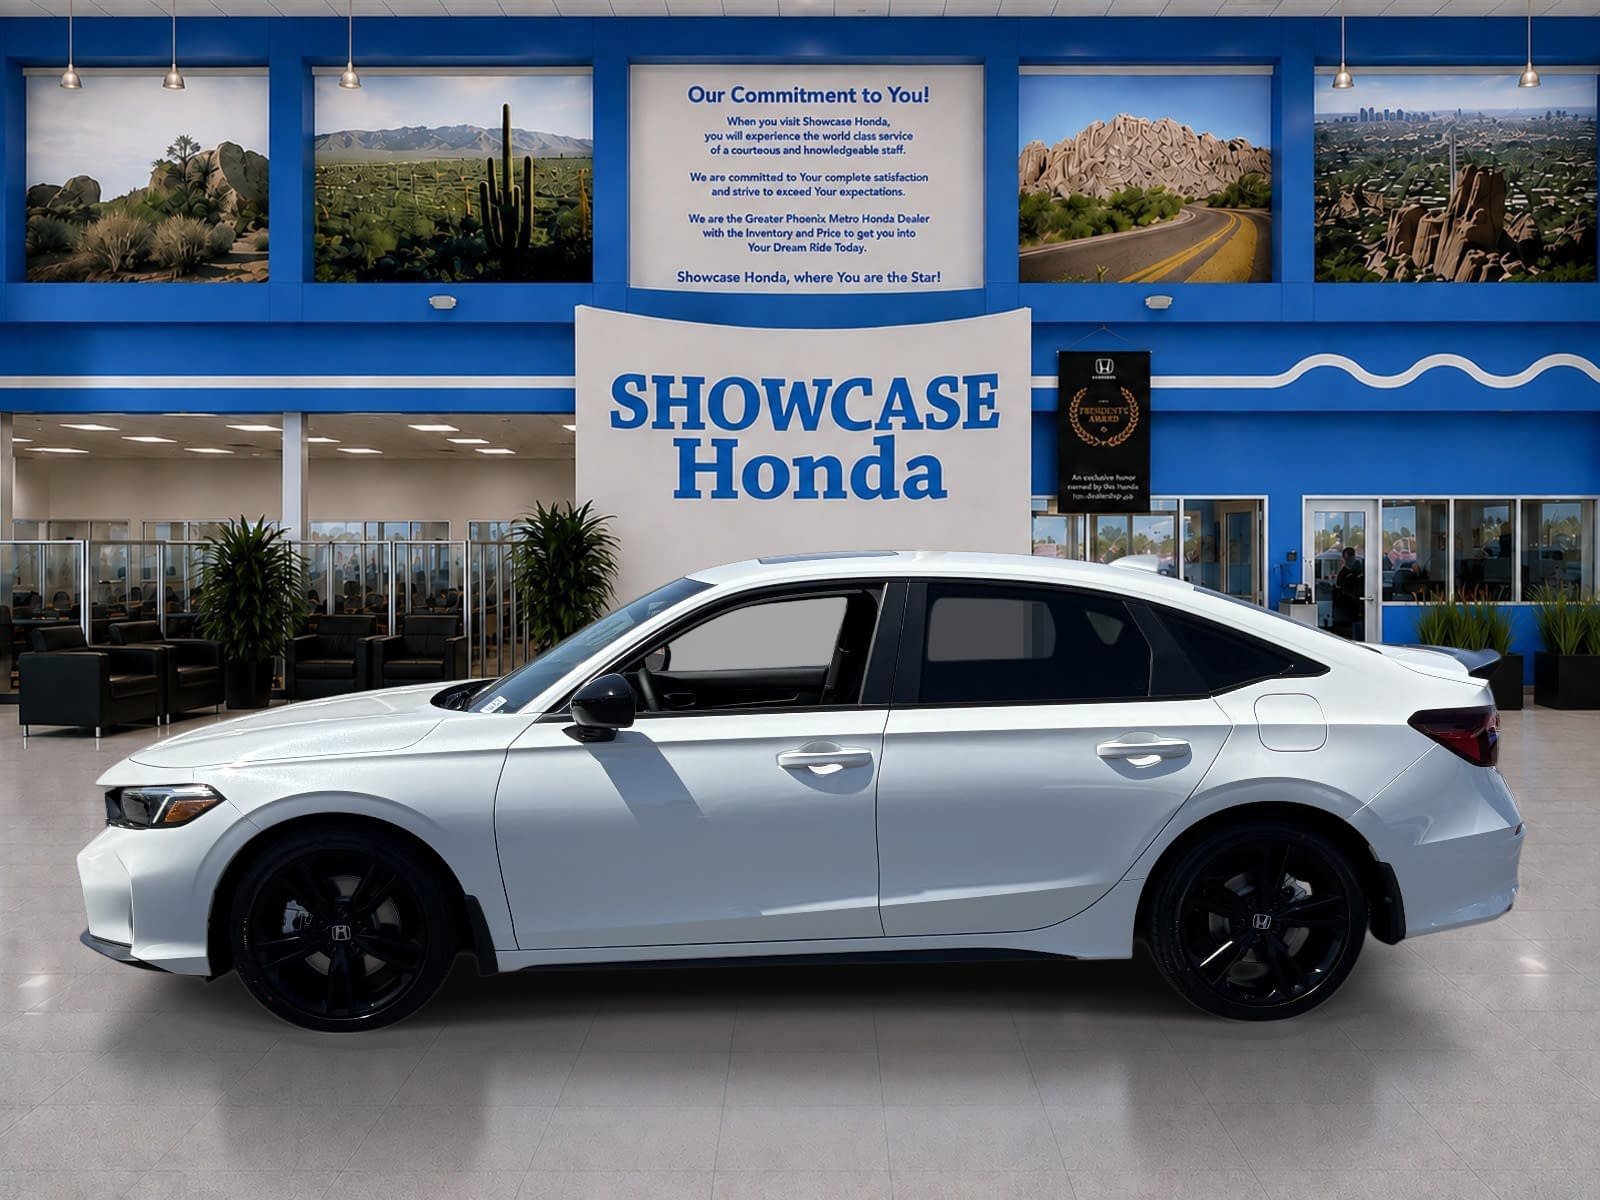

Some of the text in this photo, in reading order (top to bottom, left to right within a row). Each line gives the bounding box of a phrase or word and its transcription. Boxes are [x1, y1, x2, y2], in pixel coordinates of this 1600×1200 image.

[687, 85, 930, 104] Our Commitment to You!
[726, 115, 891, 129] When you visit Showcase Honda,
[704, 130, 914, 144] you will experience the world class service
[709, 143, 722, 156] of
[730, 146, 782, 156] courteous
[782, 144, 802, 156] and
[689, 171, 929, 186] We are committed to Your complete satisfaction
[711, 185, 906, 200] and strive to exceed Your expectations.
[687, 212, 931, 225] We are the Greater Phoenix Metro Honda Dealer
[701, 227, 917, 241] with the Inventory and Price to get you into
[747, 241, 868, 255] Your Dream Ride Today.
[676, 270, 941, 286] Showcase Honda, where You are the Star!
[610, 373, 1001, 431] SHOWCASE
[672, 434, 948, 501] Honda
